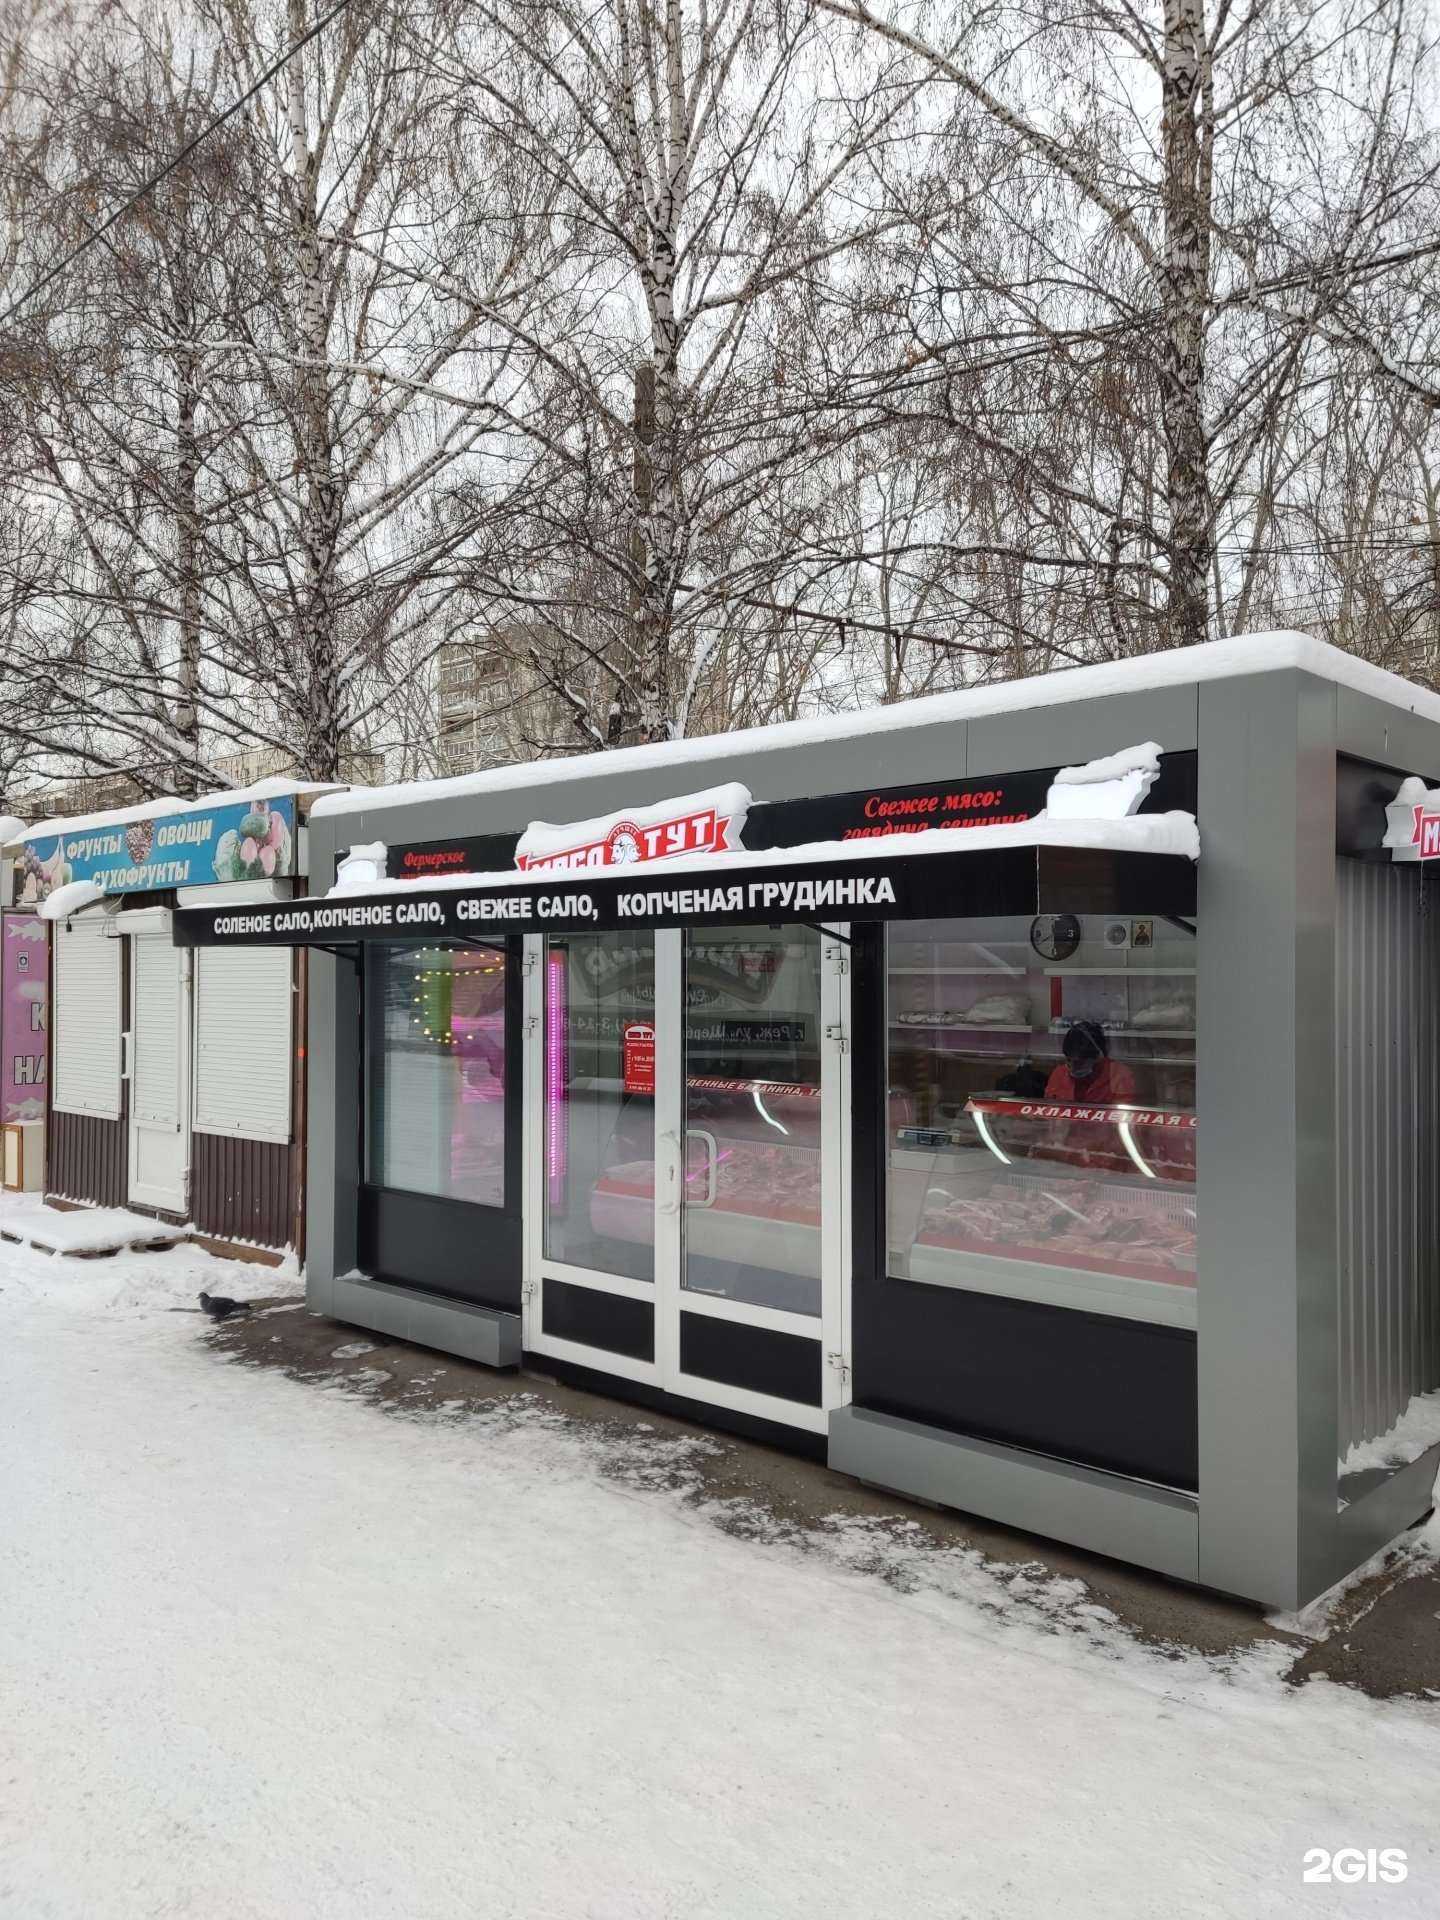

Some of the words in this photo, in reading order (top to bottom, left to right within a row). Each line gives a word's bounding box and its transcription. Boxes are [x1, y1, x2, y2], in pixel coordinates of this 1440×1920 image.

[864, 796, 938, 818] Свежее
[942, 790, 1003, 811] мясо:
[66, 833, 122, 861] ФРУКТЫ
[157, 819, 213, 847] ОВОЩИ
[644, 816, 710, 858] ТУТ
[92, 860, 191, 888] СУХОФРУКТЫ
[213, 914, 271, 934] СОЛЕНОЕ
[395, 902, 446, 925] САЛО,
[456, 897, 533, 920] СВЕЖЕЕ
[537, 894, 599, 921] САЛО,
[617, 886, 744, 916] КОПЧЕНАЯ
[748, 877, 897, 911] ГРУДИНКА
[1020, 1105, 1181, 1125] ОХЛАЖДЕННАЯ
